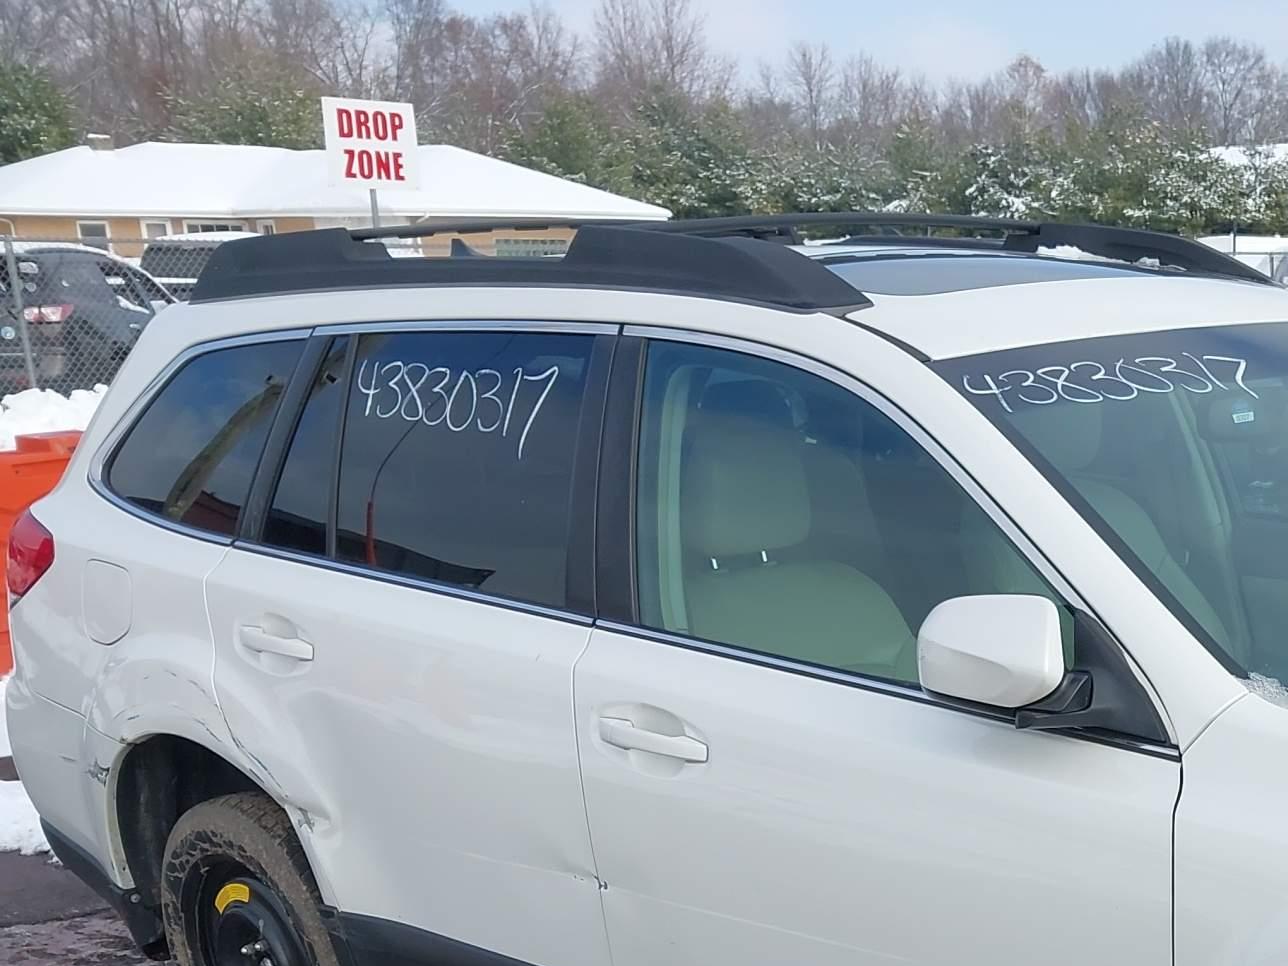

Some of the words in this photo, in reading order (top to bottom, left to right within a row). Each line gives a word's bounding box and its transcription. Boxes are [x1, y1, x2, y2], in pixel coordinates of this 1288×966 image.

[336, 108, 404, 142] DROP
[343, 149, 406, 181] ZONE
[962, 351, 1260, 413] 43830317
[357, 359, 560, 460] 43830317
